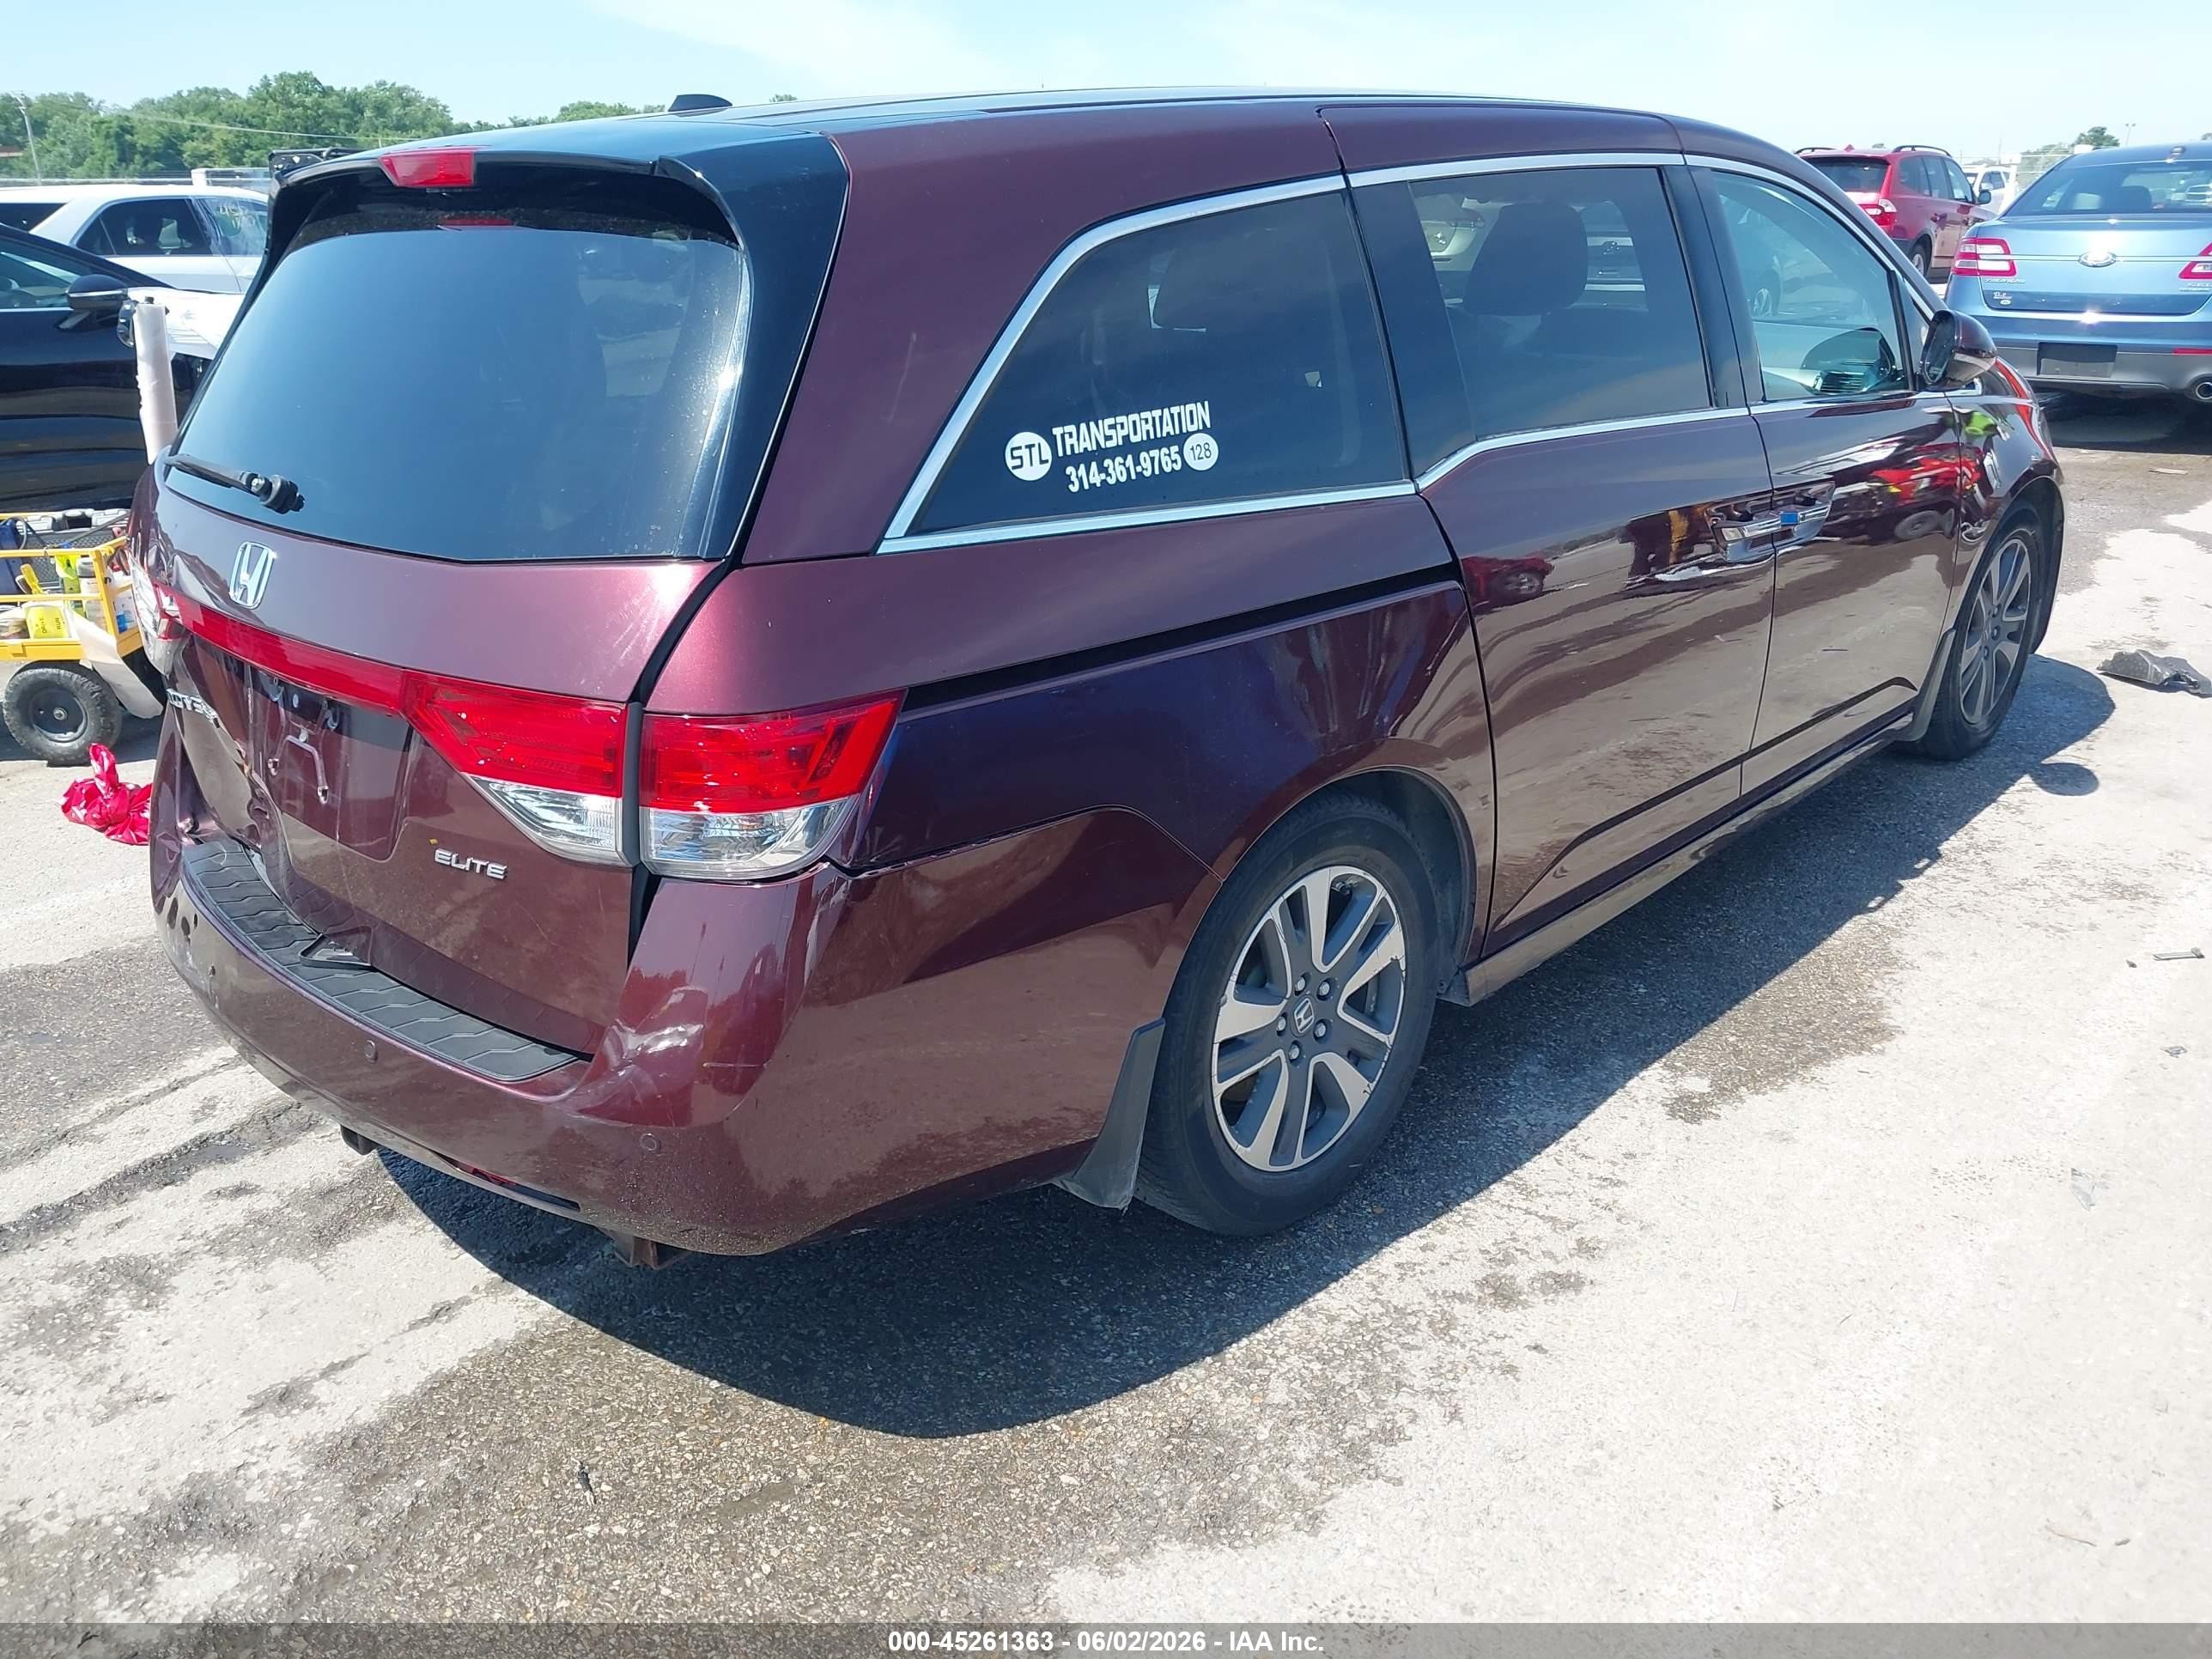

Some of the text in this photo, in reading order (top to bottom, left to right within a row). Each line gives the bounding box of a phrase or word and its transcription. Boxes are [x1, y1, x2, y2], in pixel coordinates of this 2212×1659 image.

[1052, 401, 1212, 457] TRANSPORTATION
[1010, 442, 1049, 471] STL
[1189, 442, 1212, 461] 128
[1066, 446, 1182, 493] 314-361-9765
[434, 848, 508, 880] ELITE
